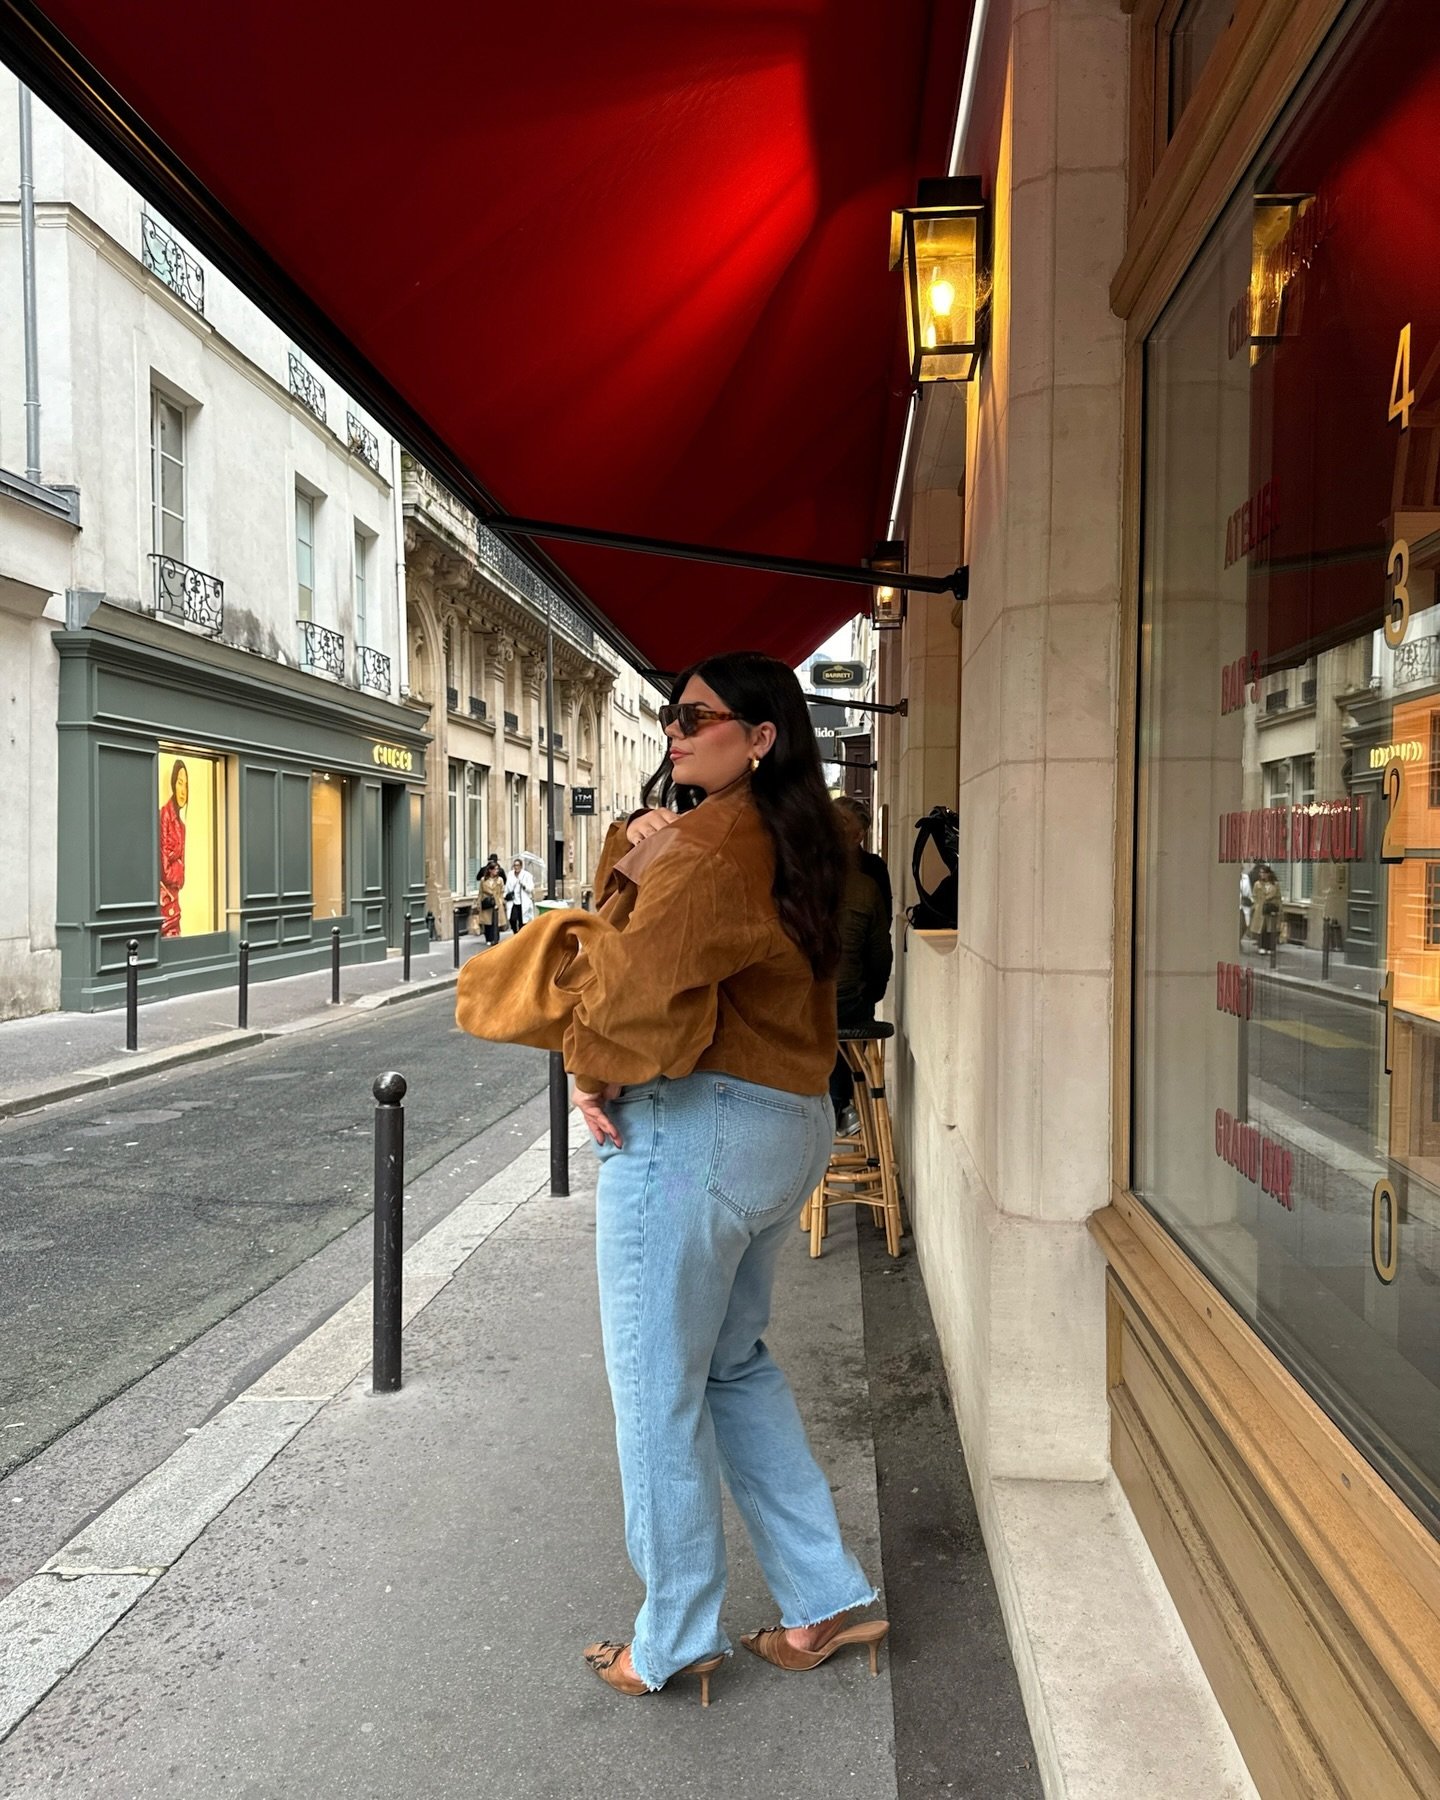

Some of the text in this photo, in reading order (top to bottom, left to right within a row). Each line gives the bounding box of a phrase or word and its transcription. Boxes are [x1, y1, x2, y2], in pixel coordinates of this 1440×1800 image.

[1388, 322, 1414, 432] 4
[1224, 474, 1280, 570] ATELIER
[1384, 538, 1410, 650] 3
[373, 744, 413, 771] GUCCI
[1380, 756, 1405, 864] 2
[1379, 971, 1394, 1075] 1
[1215, 1107, 1294, 1212] GRAND BAR
[1371, 1178, 1397, 1285] 0
